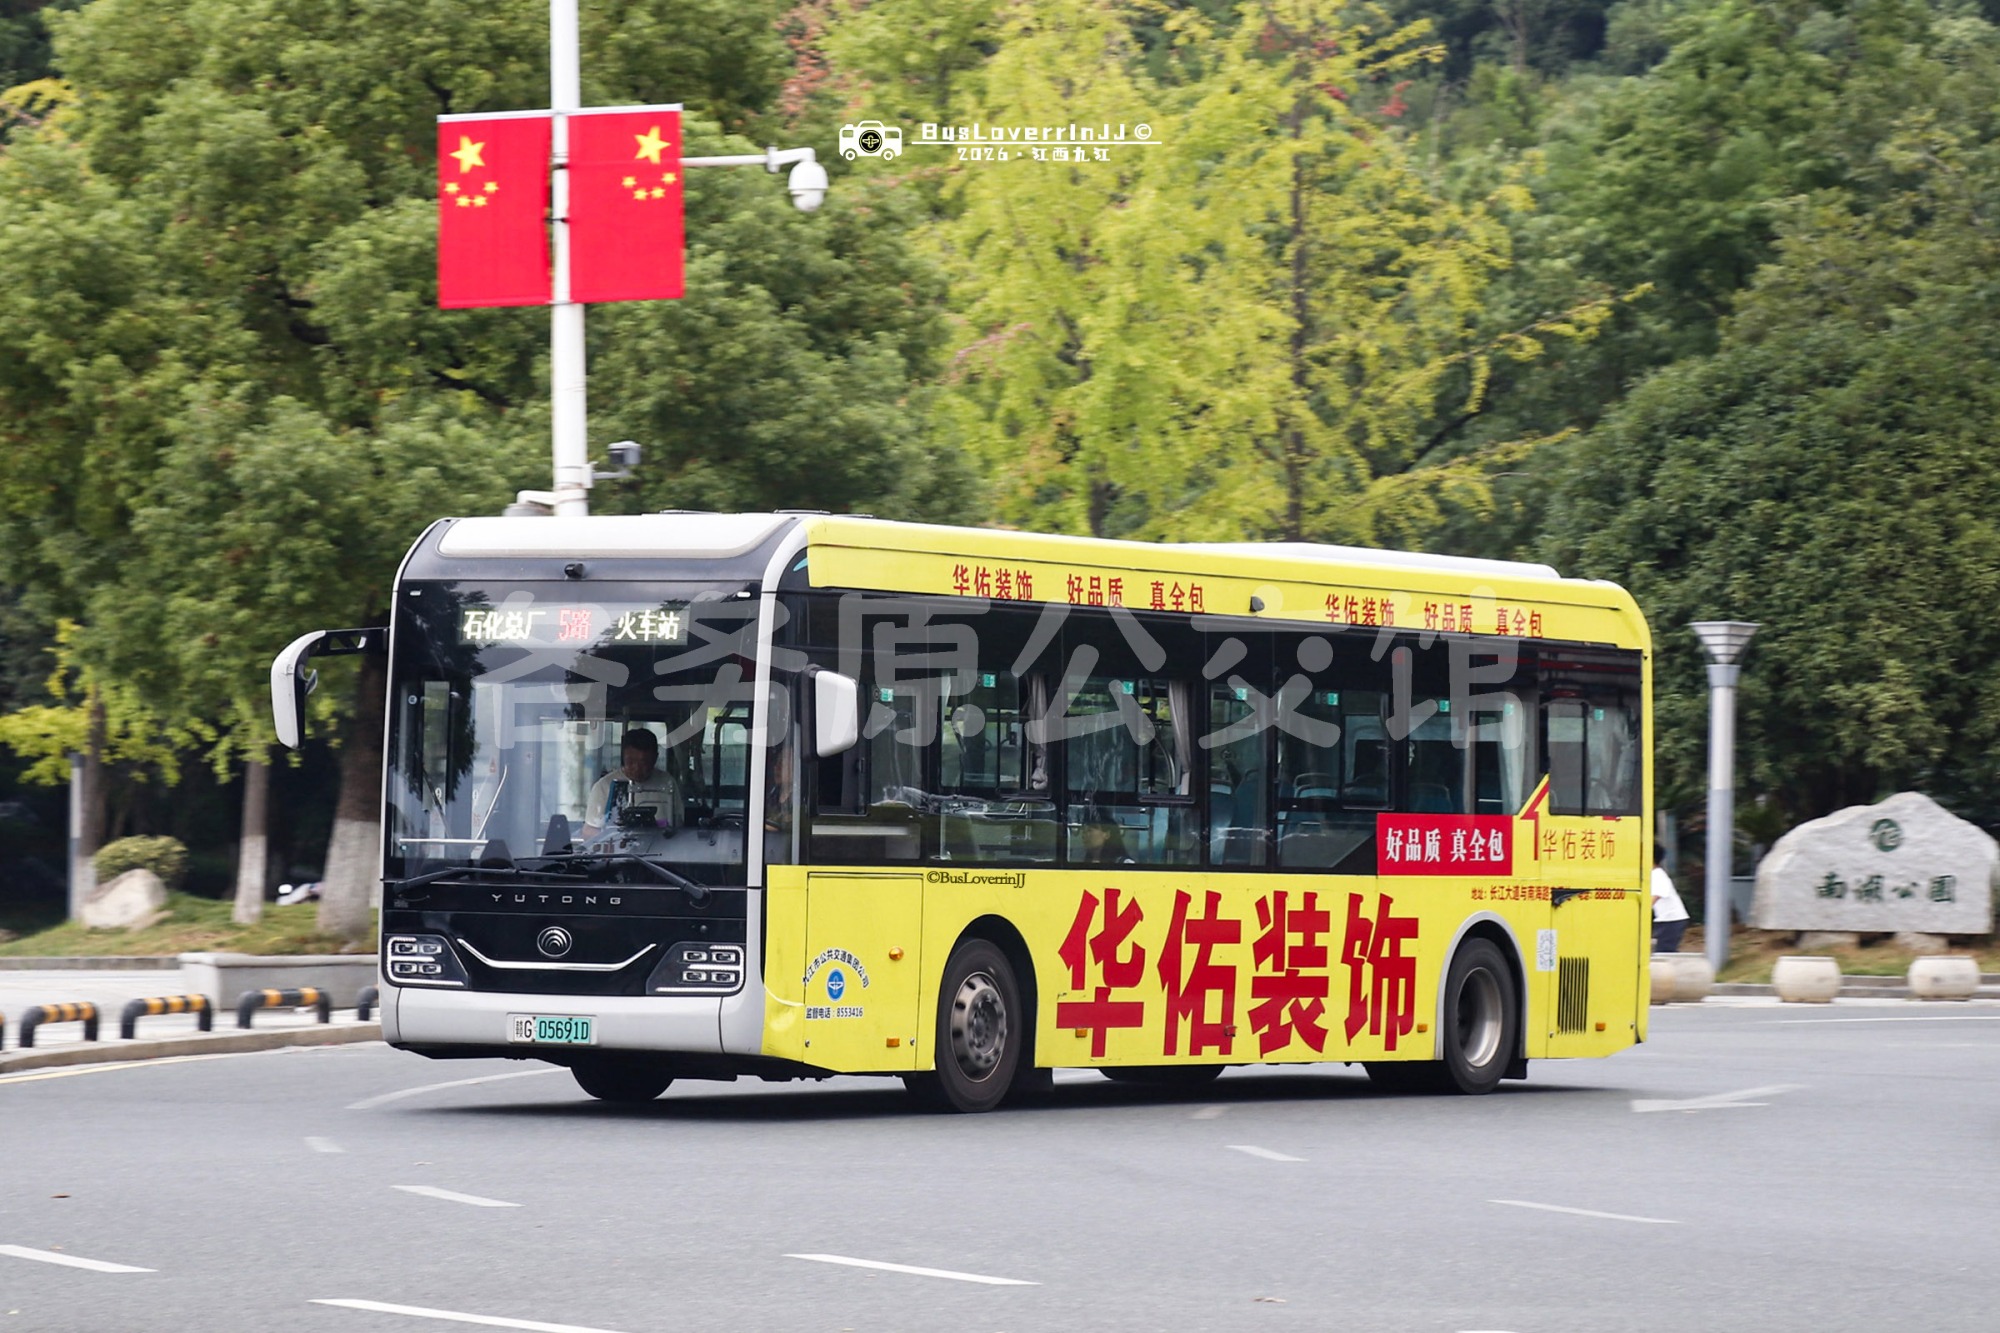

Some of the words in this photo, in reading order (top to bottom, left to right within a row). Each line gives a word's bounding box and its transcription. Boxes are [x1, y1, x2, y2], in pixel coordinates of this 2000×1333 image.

[953, 564, 1033, 601] 华佑装饰
[1067, 573, 1123, 607] 好品质
[1150, 580, 1205, 613] 真全包
[463, 610, 546, 640] 石化总厂
[558, 609, 592, 641] 5路
[615, 610, 680, 642] 火车站
[1325, 593, 1395, 627] 华佑装饰
[1424, 601, 1473, 633] 好品质
[1496, 607, 1543, 638] 真全包
[1386, 827, 1442, 862] 好品质
[1451, 828, 1504, 862] 真全包
[1542, 828, 1616, 861] 华佑装饰
[492, 893, 622, 905] YUTONG
[1056, 888, 1419, 1059] 华佑装饰
